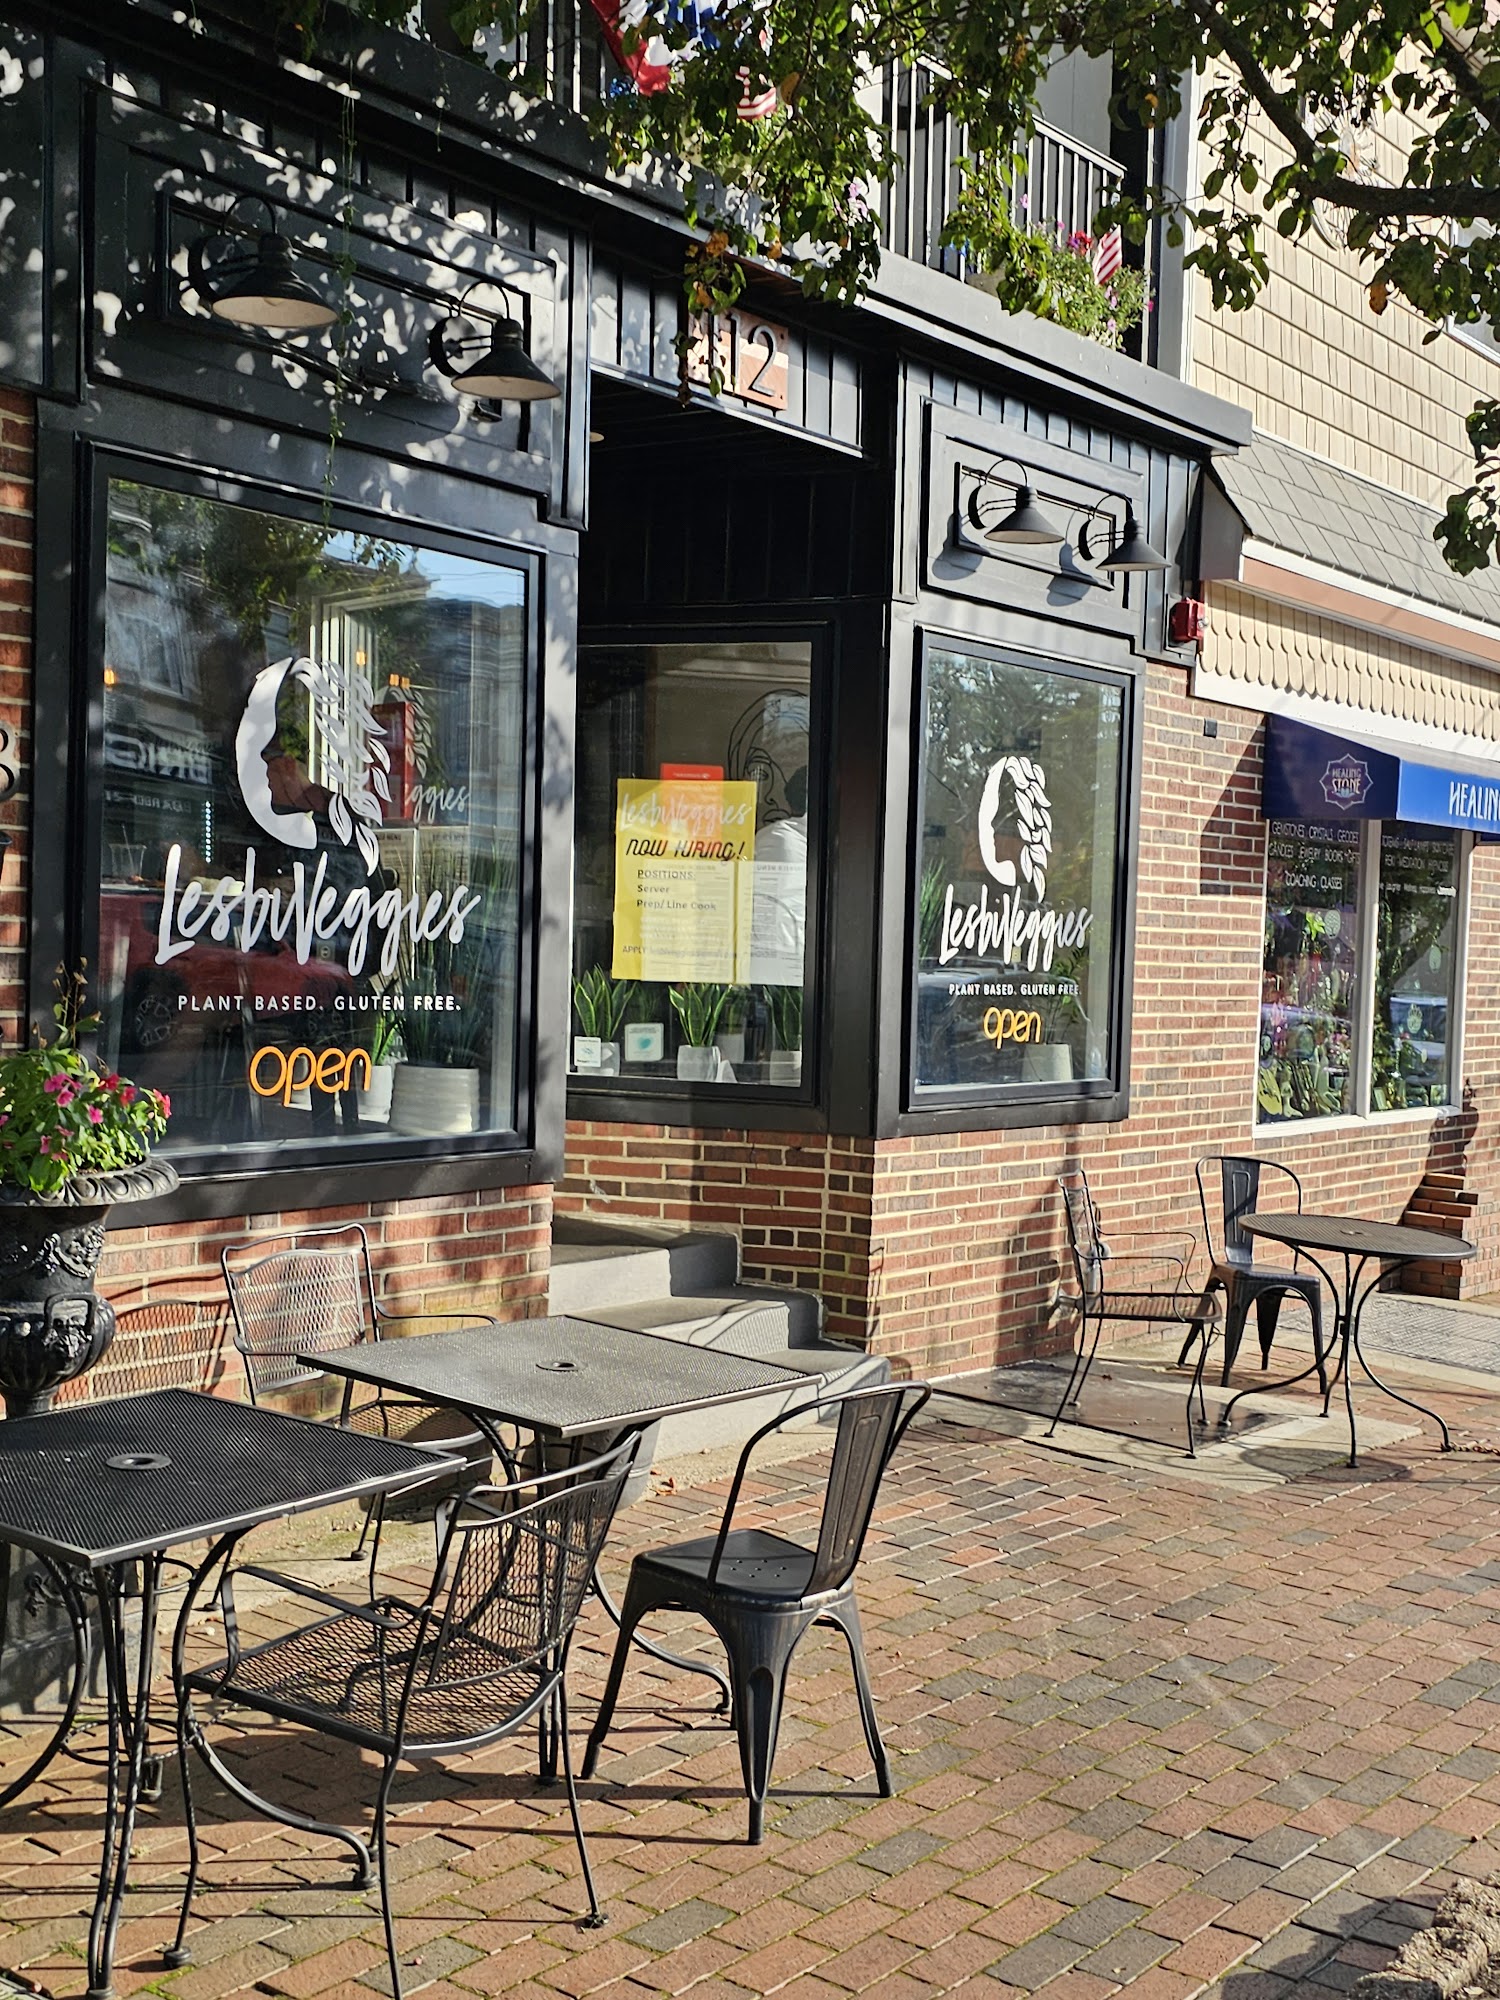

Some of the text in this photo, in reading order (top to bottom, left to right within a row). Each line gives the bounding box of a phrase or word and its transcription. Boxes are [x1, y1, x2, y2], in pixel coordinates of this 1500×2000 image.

[1331, 778, 1361, 795] STONE
[1449, 781, 1500, 821] HEALIN
[637, 884, 670, 893] Server
[154, 843, 481, 976] LesbiVeggies
[691, 901, 717, 911] Cook
[939, 883, 1093, 972] LesbiVeggies
[178, 995, 462, 1011] PLANT BASED. GLUTEN FREE.
[949, 983, 1082, 996] PLANT BASED. GLUTEN FREE.
[984, 1006, 1042, 1050] open
[250, 1045, 372, 1107] open
